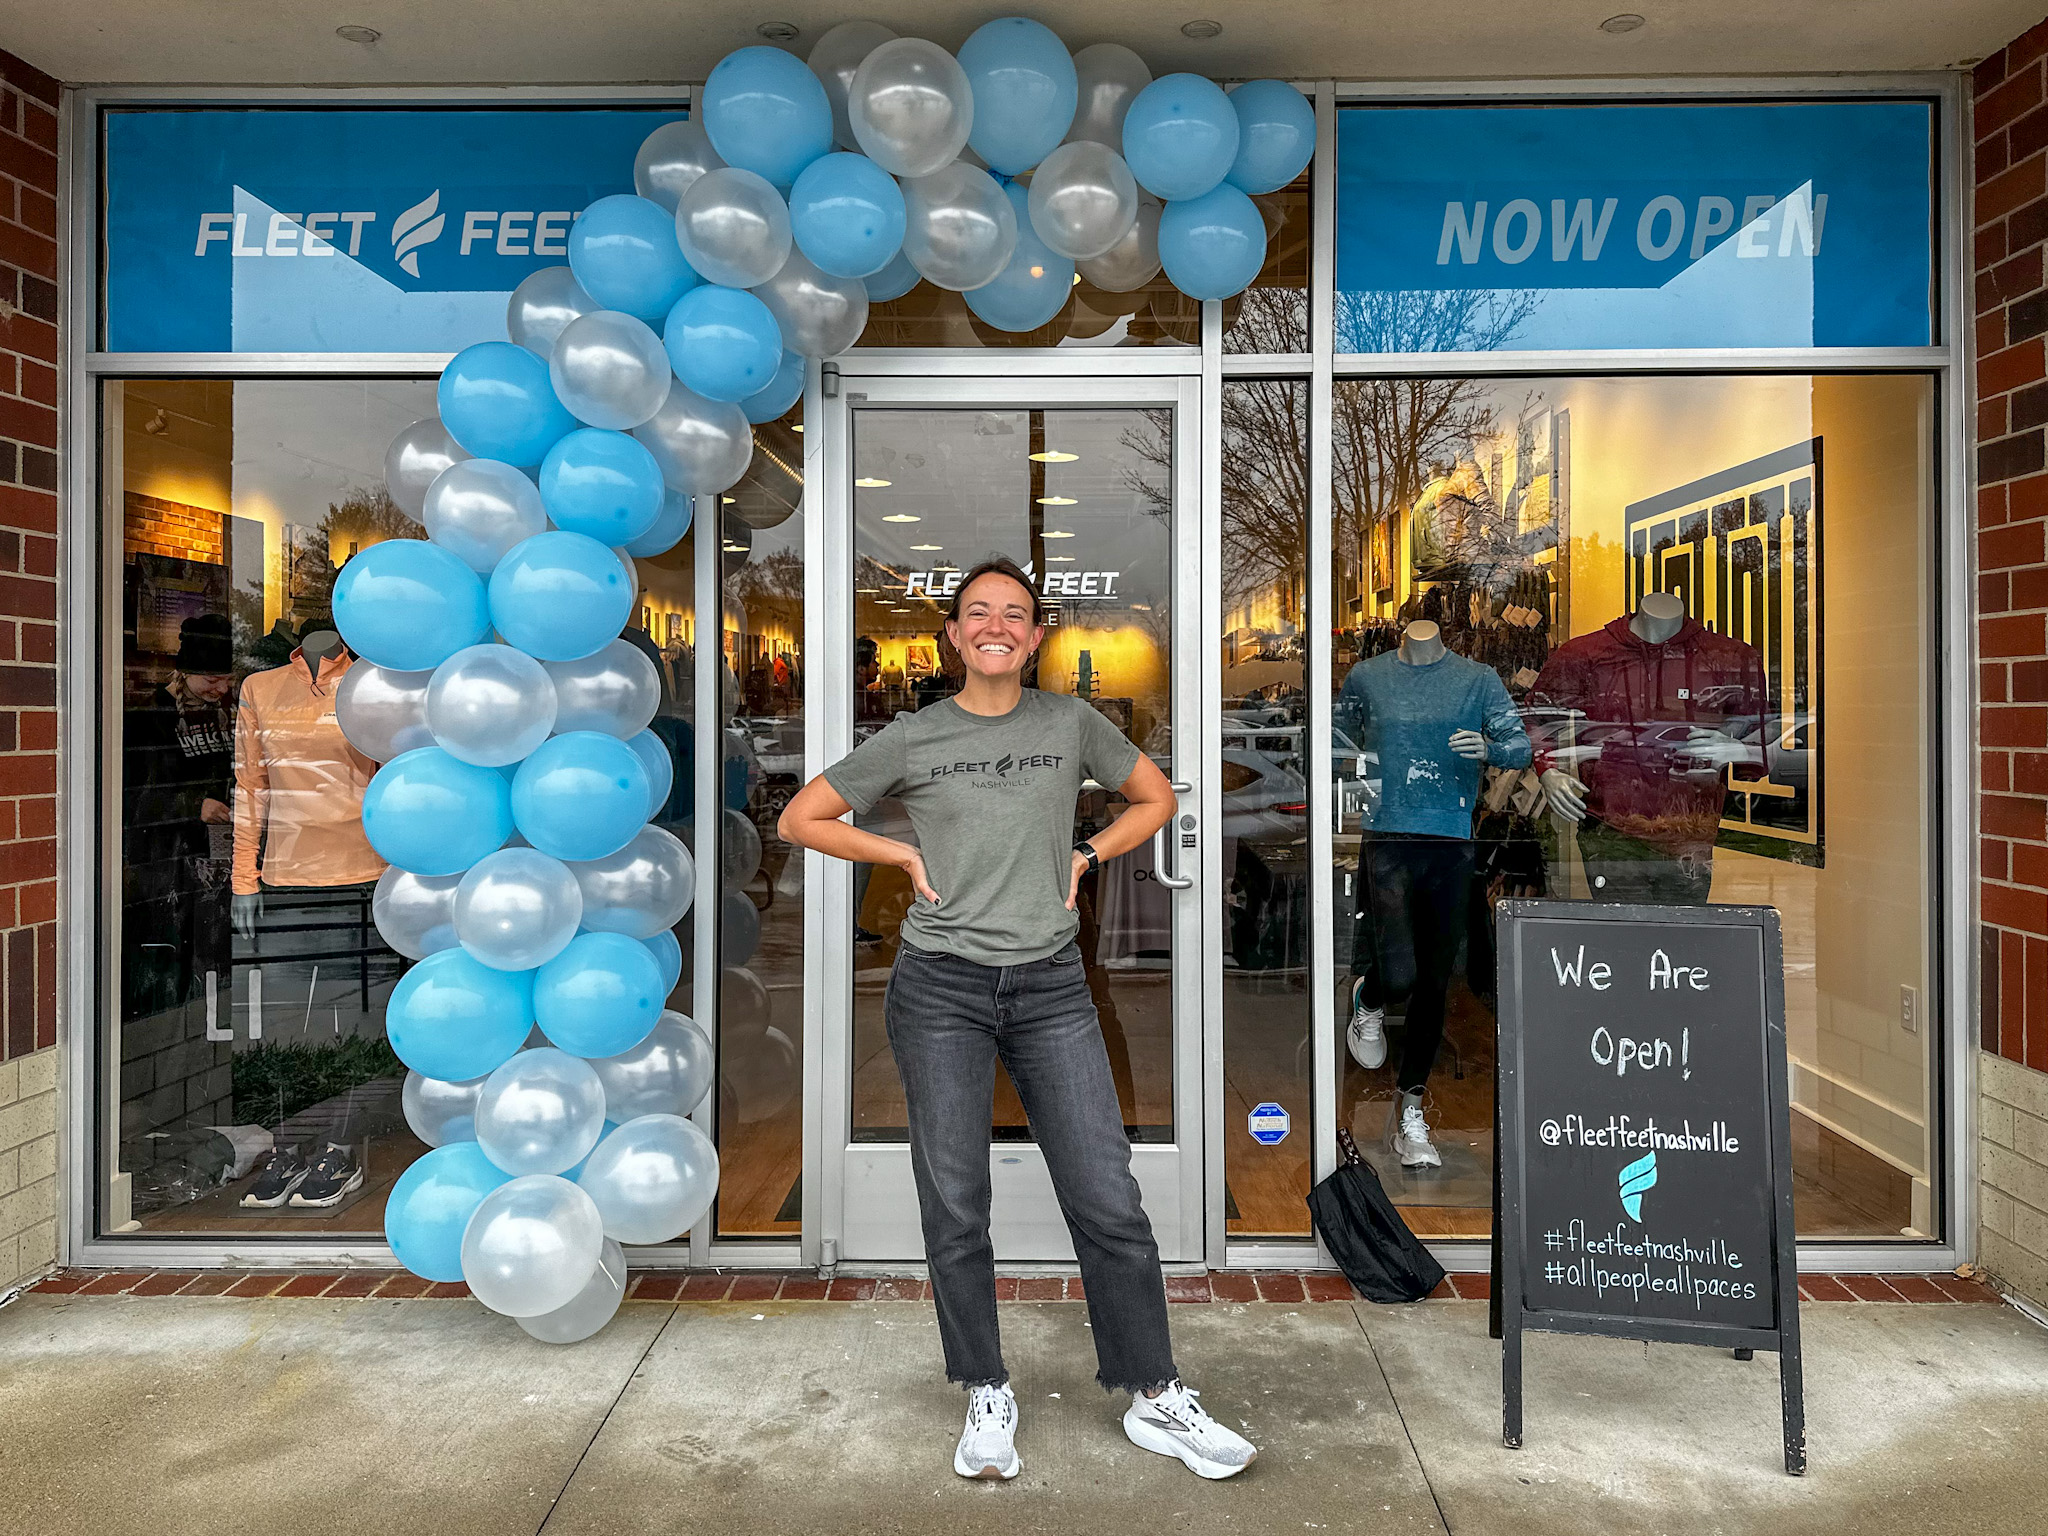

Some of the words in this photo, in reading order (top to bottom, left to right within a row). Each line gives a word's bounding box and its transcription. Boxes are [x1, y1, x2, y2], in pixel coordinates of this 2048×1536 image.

[195, 211, 376, 257] FLEET
[459, 211, 580, 256] FEE
[1436, 198, 1619, 265] NOW
[1636, 194, 1829, 262] OPEN
[906, 572, 970, 596] FLE
[930, 761, 990, 779] FLEET
[1018, 755, 1063, 771] FEET
[971, 778, 1031, 789] NASHVILLE
[1551, 945, 1612, 990] We
[1650, 949, 1711, 991] Are
[1591, 1026, 1692, 1082] Open!
[1539, 1114, 1740, 1153] @fleetfeetnashville
[1544, 1218, 1743, 1269] #fleetfeetnashville
[1544, 1257, 1756, 1310] #allpeopleallpaces
